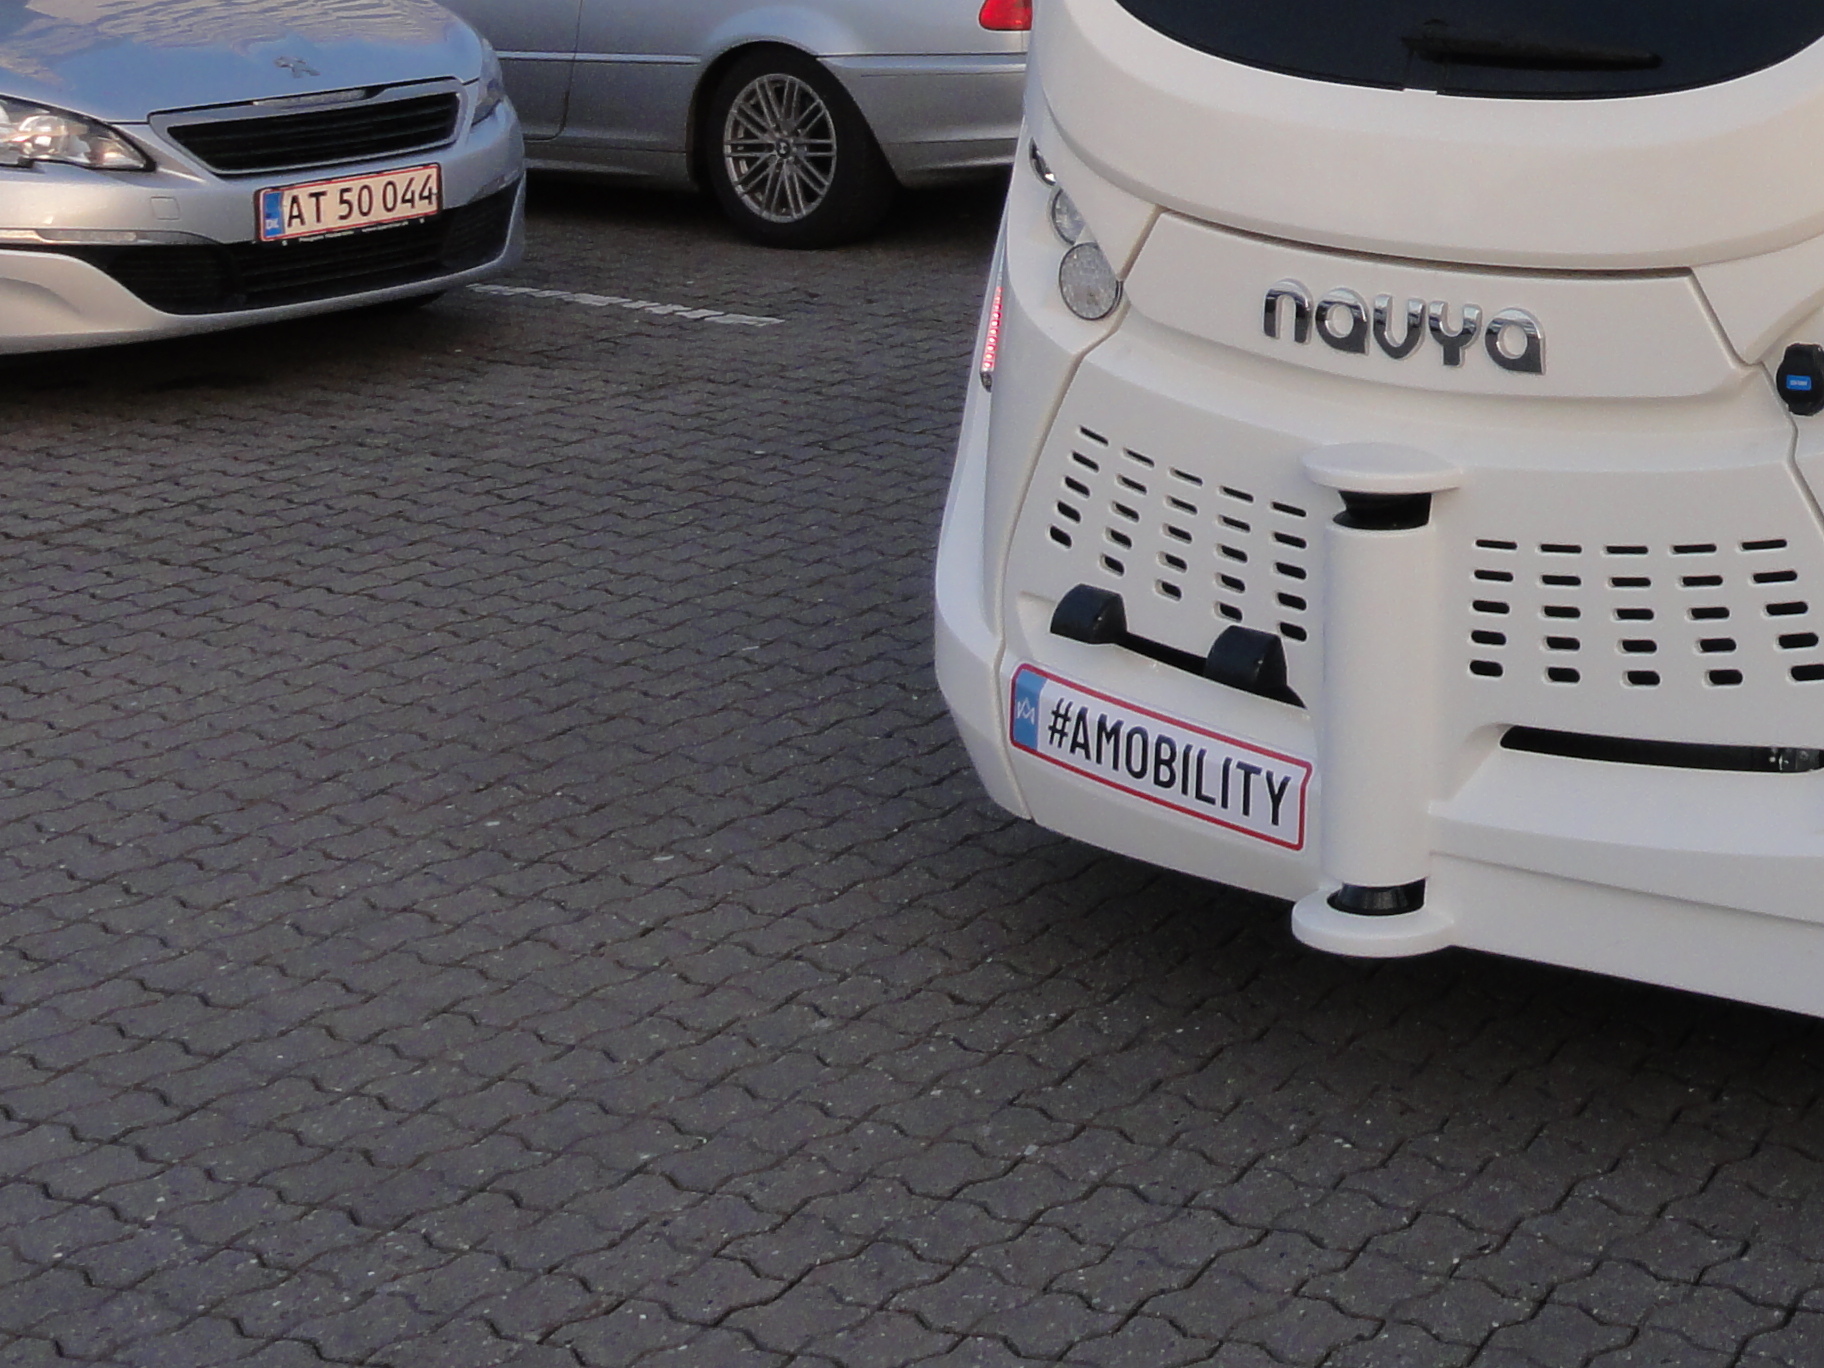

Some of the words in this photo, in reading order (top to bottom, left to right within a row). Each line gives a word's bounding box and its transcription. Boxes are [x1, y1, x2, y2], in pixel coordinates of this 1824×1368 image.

[287, 189, 328, 229] AT
[338, 184, 373, 221] 50
[382, 173, 434, 213] 044
[1046, 695, 1292, 827] #AMOBILITY
